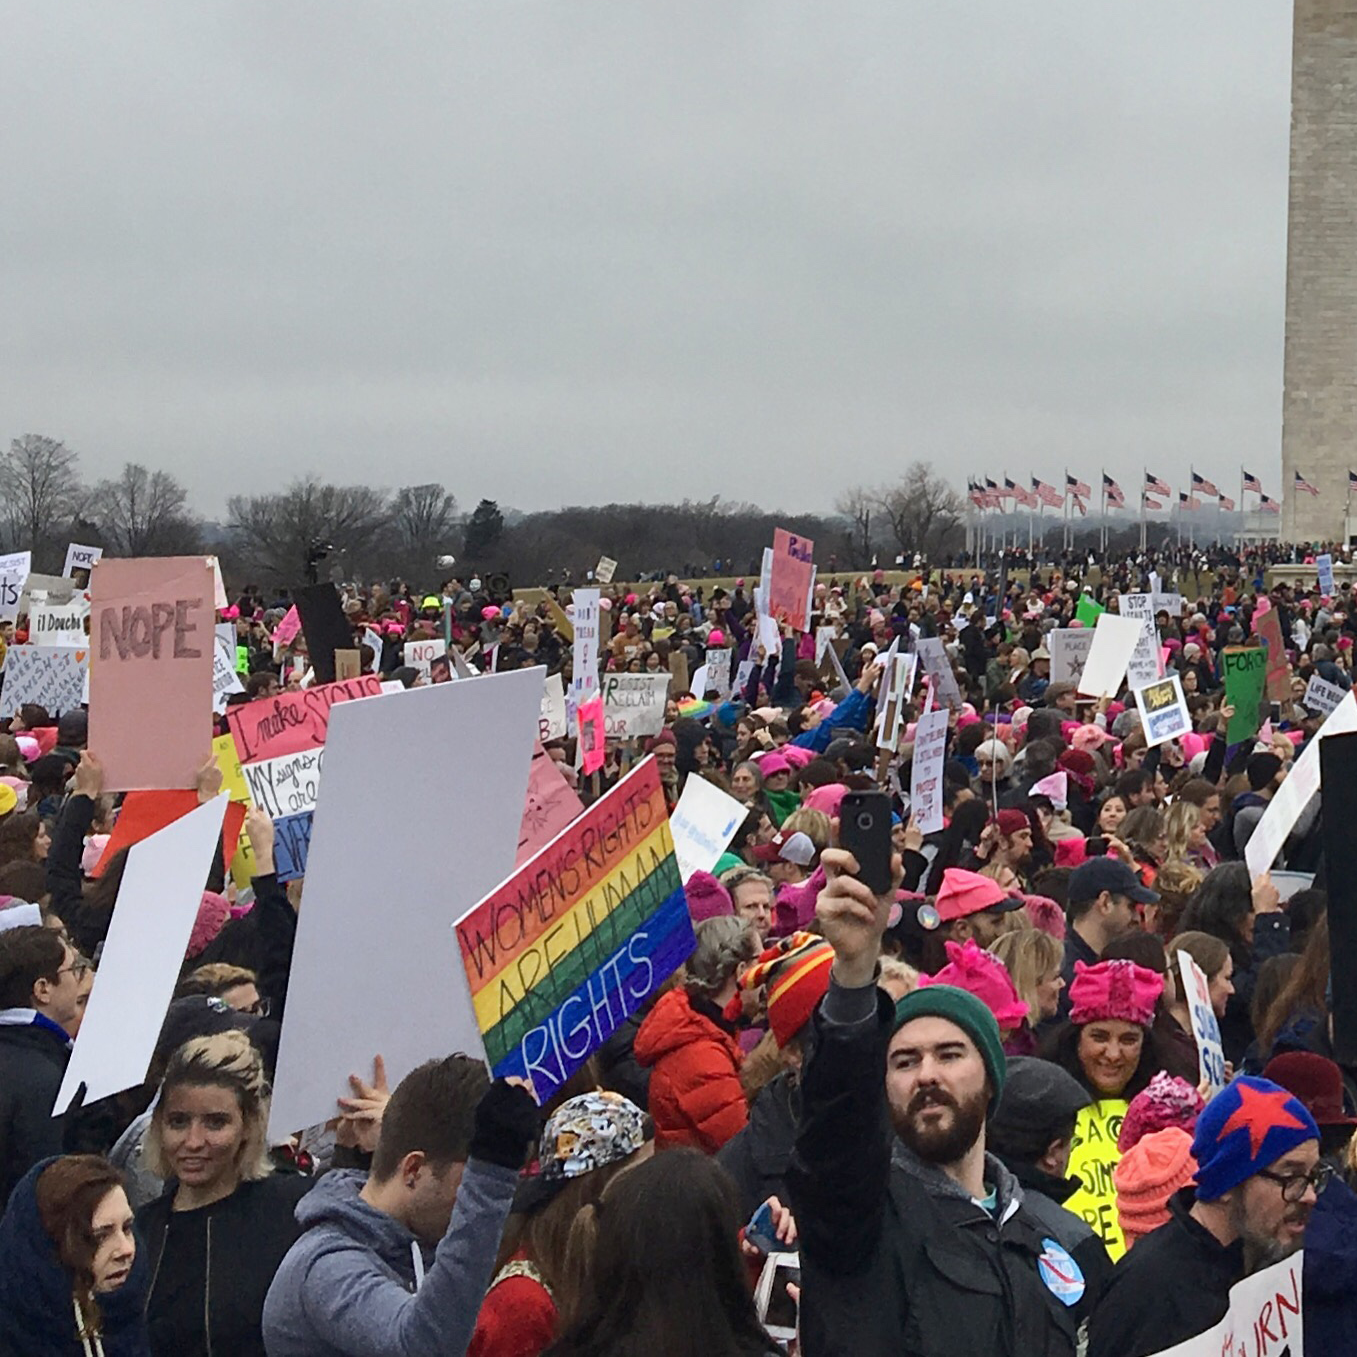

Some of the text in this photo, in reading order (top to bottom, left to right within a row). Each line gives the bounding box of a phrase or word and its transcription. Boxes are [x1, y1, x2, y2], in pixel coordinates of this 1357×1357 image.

[1127, 596, 1147, 609] STOP
[100, 599, 203, 661] NOPE
[4, 650, 42, 692] QUEER
[412, 645, 435, 661] NO
[4, 656, 52, 714] JEWISH
[606, 677, 655, 695] RESIST
[606, 690, 656, 707] RECLAIM
[1310, 682, 1327, 698] LIFE
[227, 705, 257, 764] I
[255, 699, 308, 748] make
[604, 715, 627, 734] OUR
[275, 754, 317, 788] signs
[245, 762, 284, 819] MY
[288, 781, 319, 812] are
[462, 850, 581, 980] WOMEN'S
[581, 783, 652, 878] RIGHTS
[498, 827, 677, 1053] ARE HUMAN
[521, 932, 654, 1085] RIGHTS
